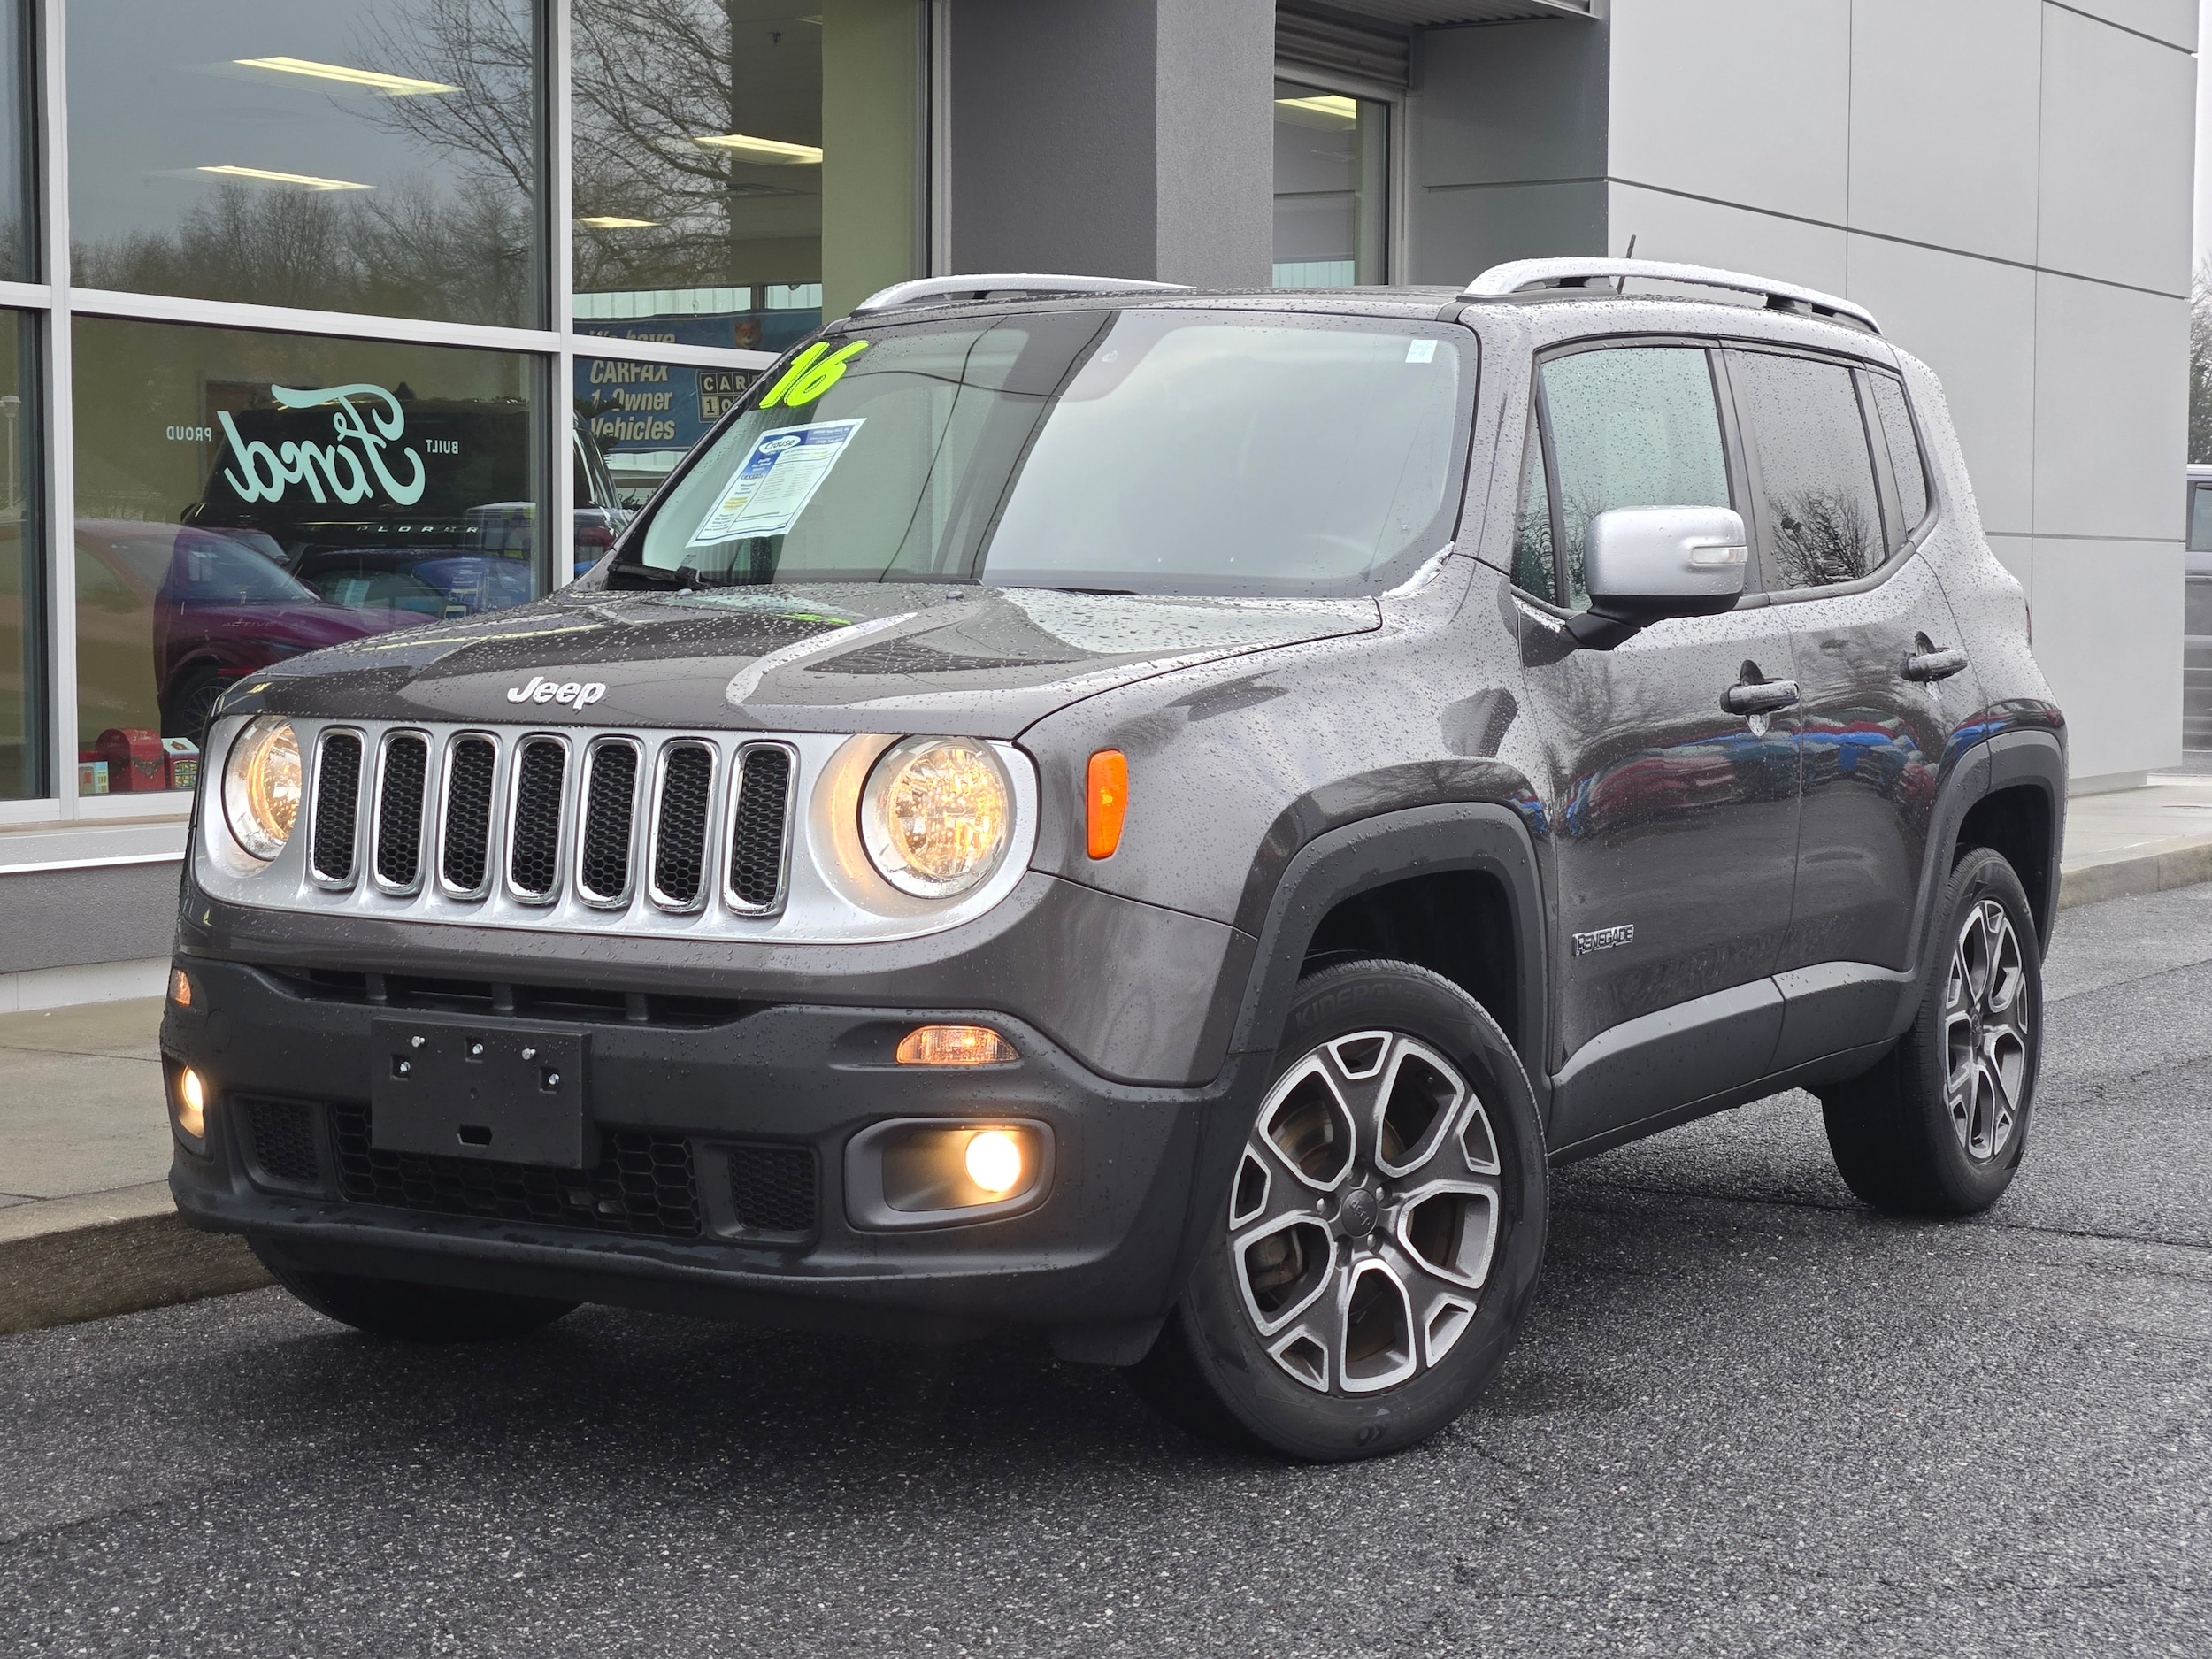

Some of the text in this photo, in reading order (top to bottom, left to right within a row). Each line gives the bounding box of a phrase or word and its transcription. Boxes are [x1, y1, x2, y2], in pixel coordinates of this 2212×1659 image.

[590, 360, 668, 384] CARFAX
[759, 340, 869, 409] 16
[590, 416, 675, 440] Vehicles
[764, 437, 796, 450] Crouse
[507, 676, 606, 711] Jeep
[1572, 924, 1634, 956] RENEGADE
